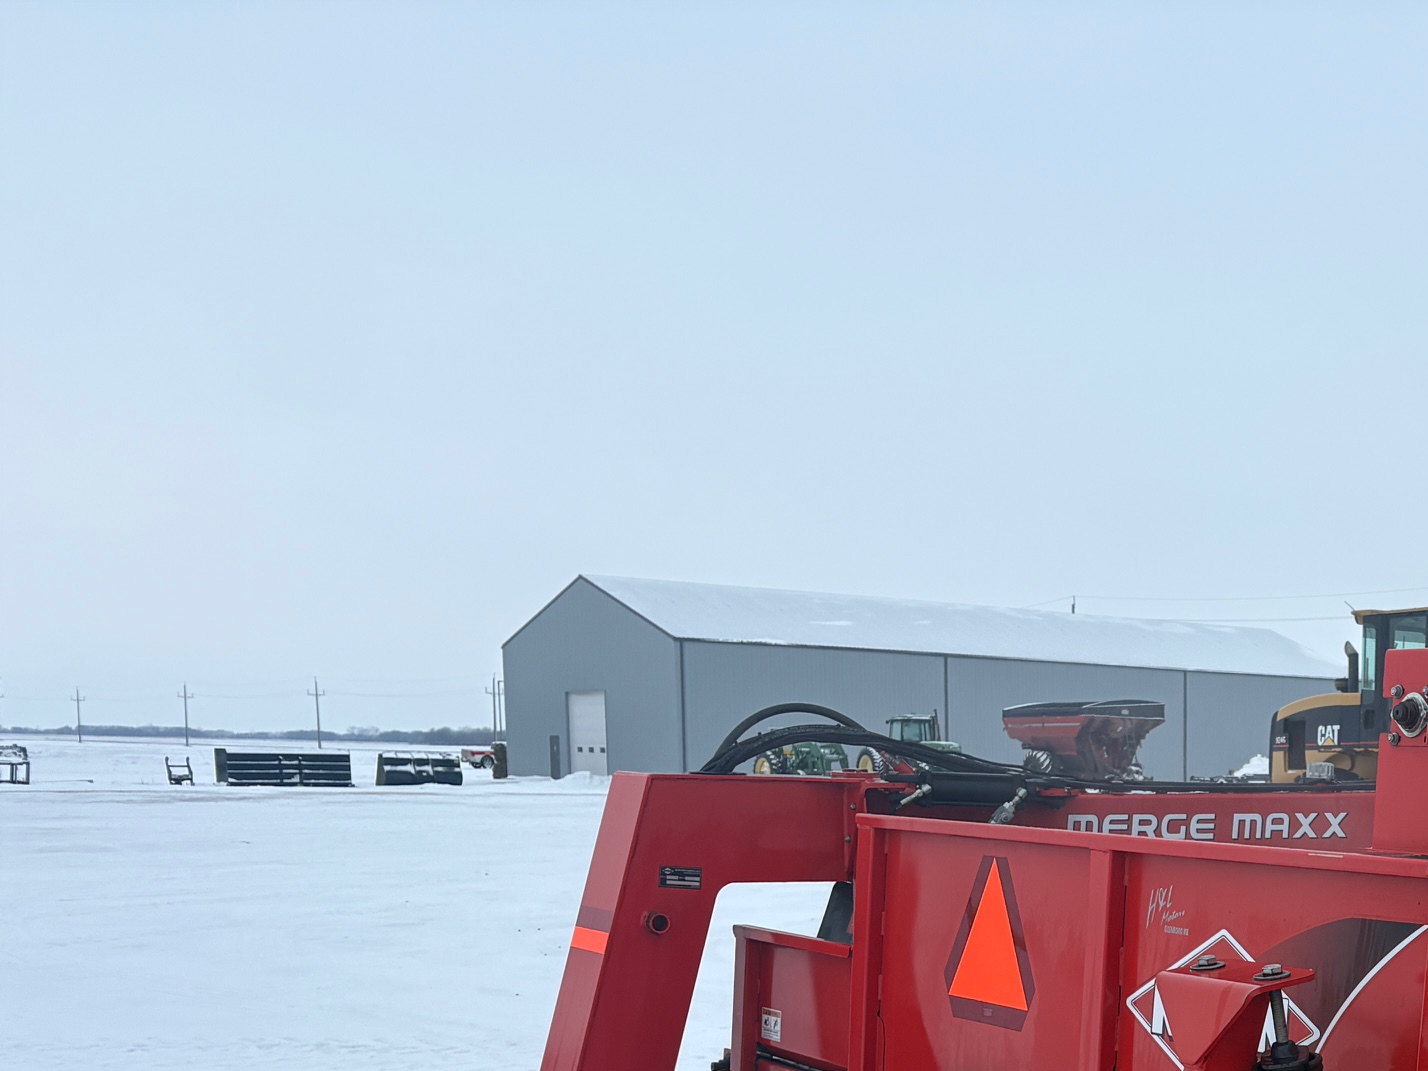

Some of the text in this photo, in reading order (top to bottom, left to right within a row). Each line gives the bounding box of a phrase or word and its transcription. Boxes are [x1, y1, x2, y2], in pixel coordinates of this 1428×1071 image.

[1317, 724, 1340, 746] CAT
[1067, 812, 1348, 840] MERGE MAXX
